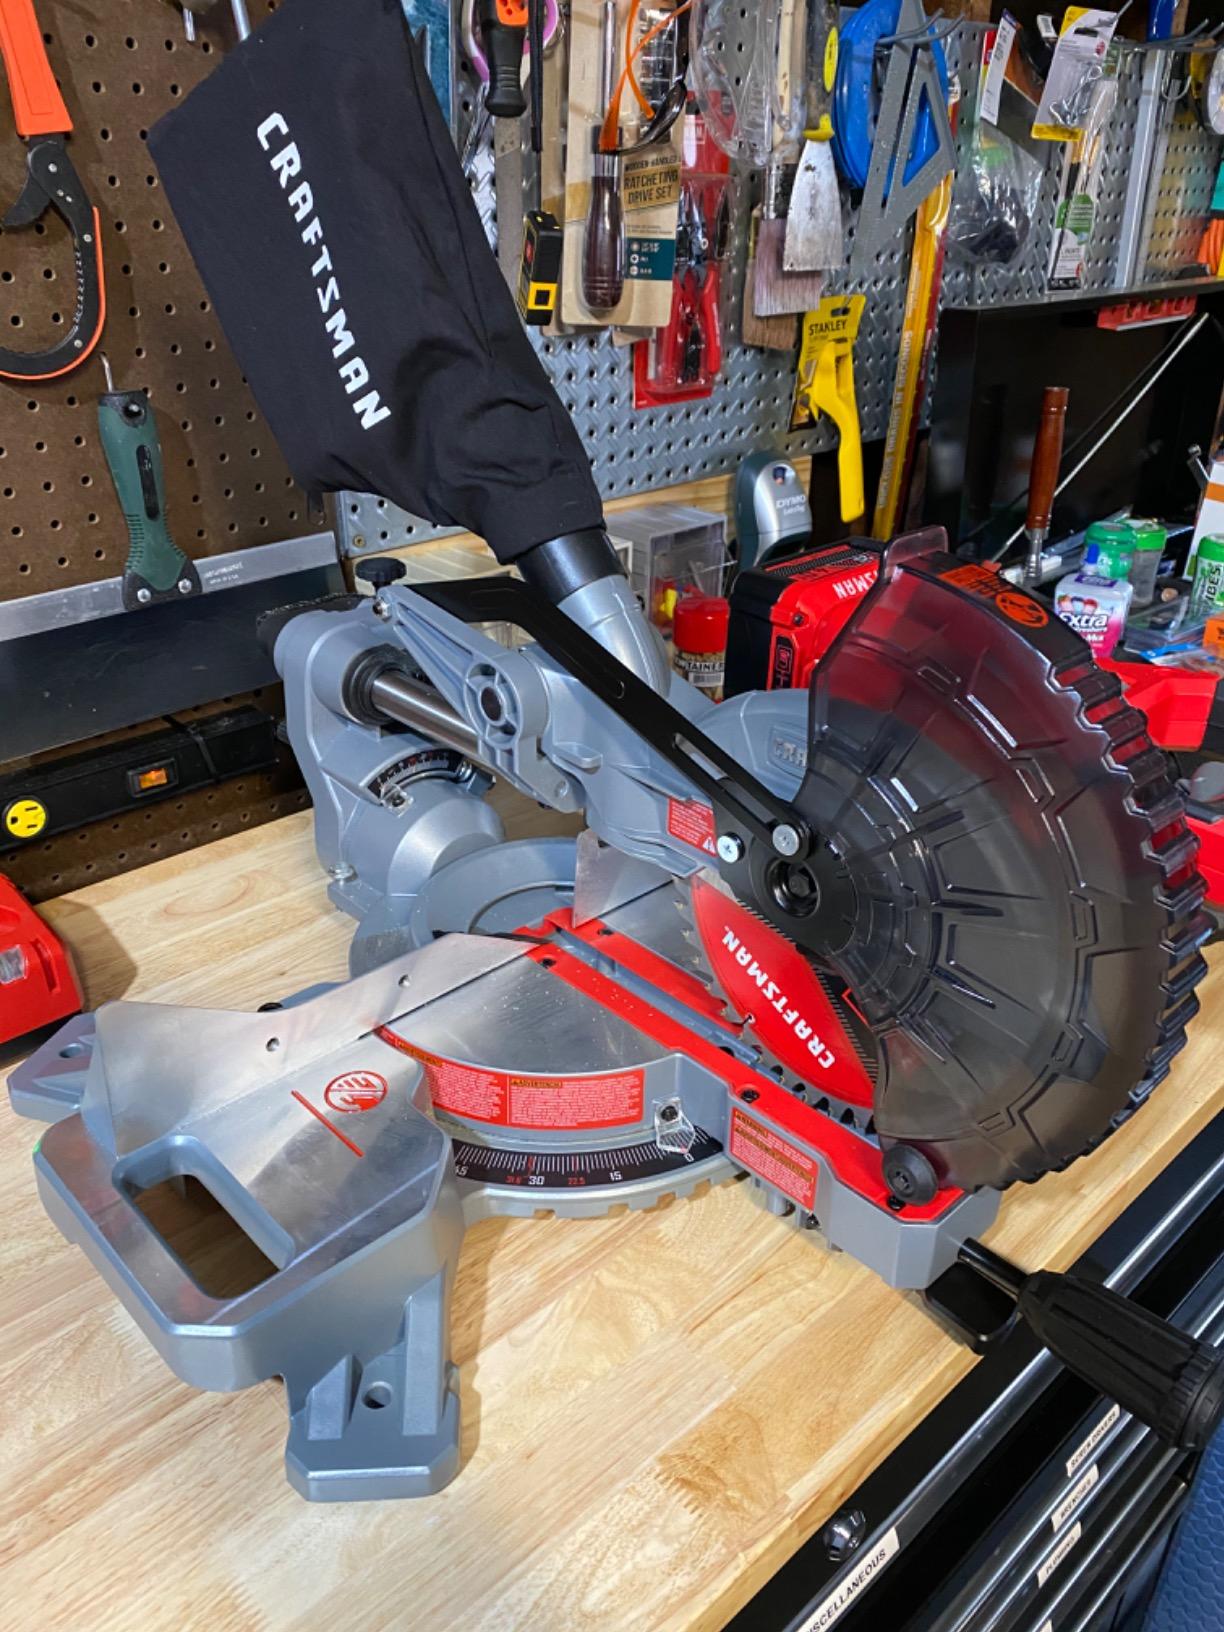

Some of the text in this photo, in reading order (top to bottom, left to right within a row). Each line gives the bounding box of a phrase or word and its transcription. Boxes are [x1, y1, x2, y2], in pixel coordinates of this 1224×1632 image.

[624, 169, 678, 190] RATCHETING
[628, 185, 672, 204] DRIVE SET
[257, 112, 391, 430] CRAFTSMAN
[809, 320, 847, 336] STANLEY
[722, 930, 835, 1069] CRAFTSMAN
[528, 1175, 545, 1185] 30
[609, 1171, 623, 1182] 15
